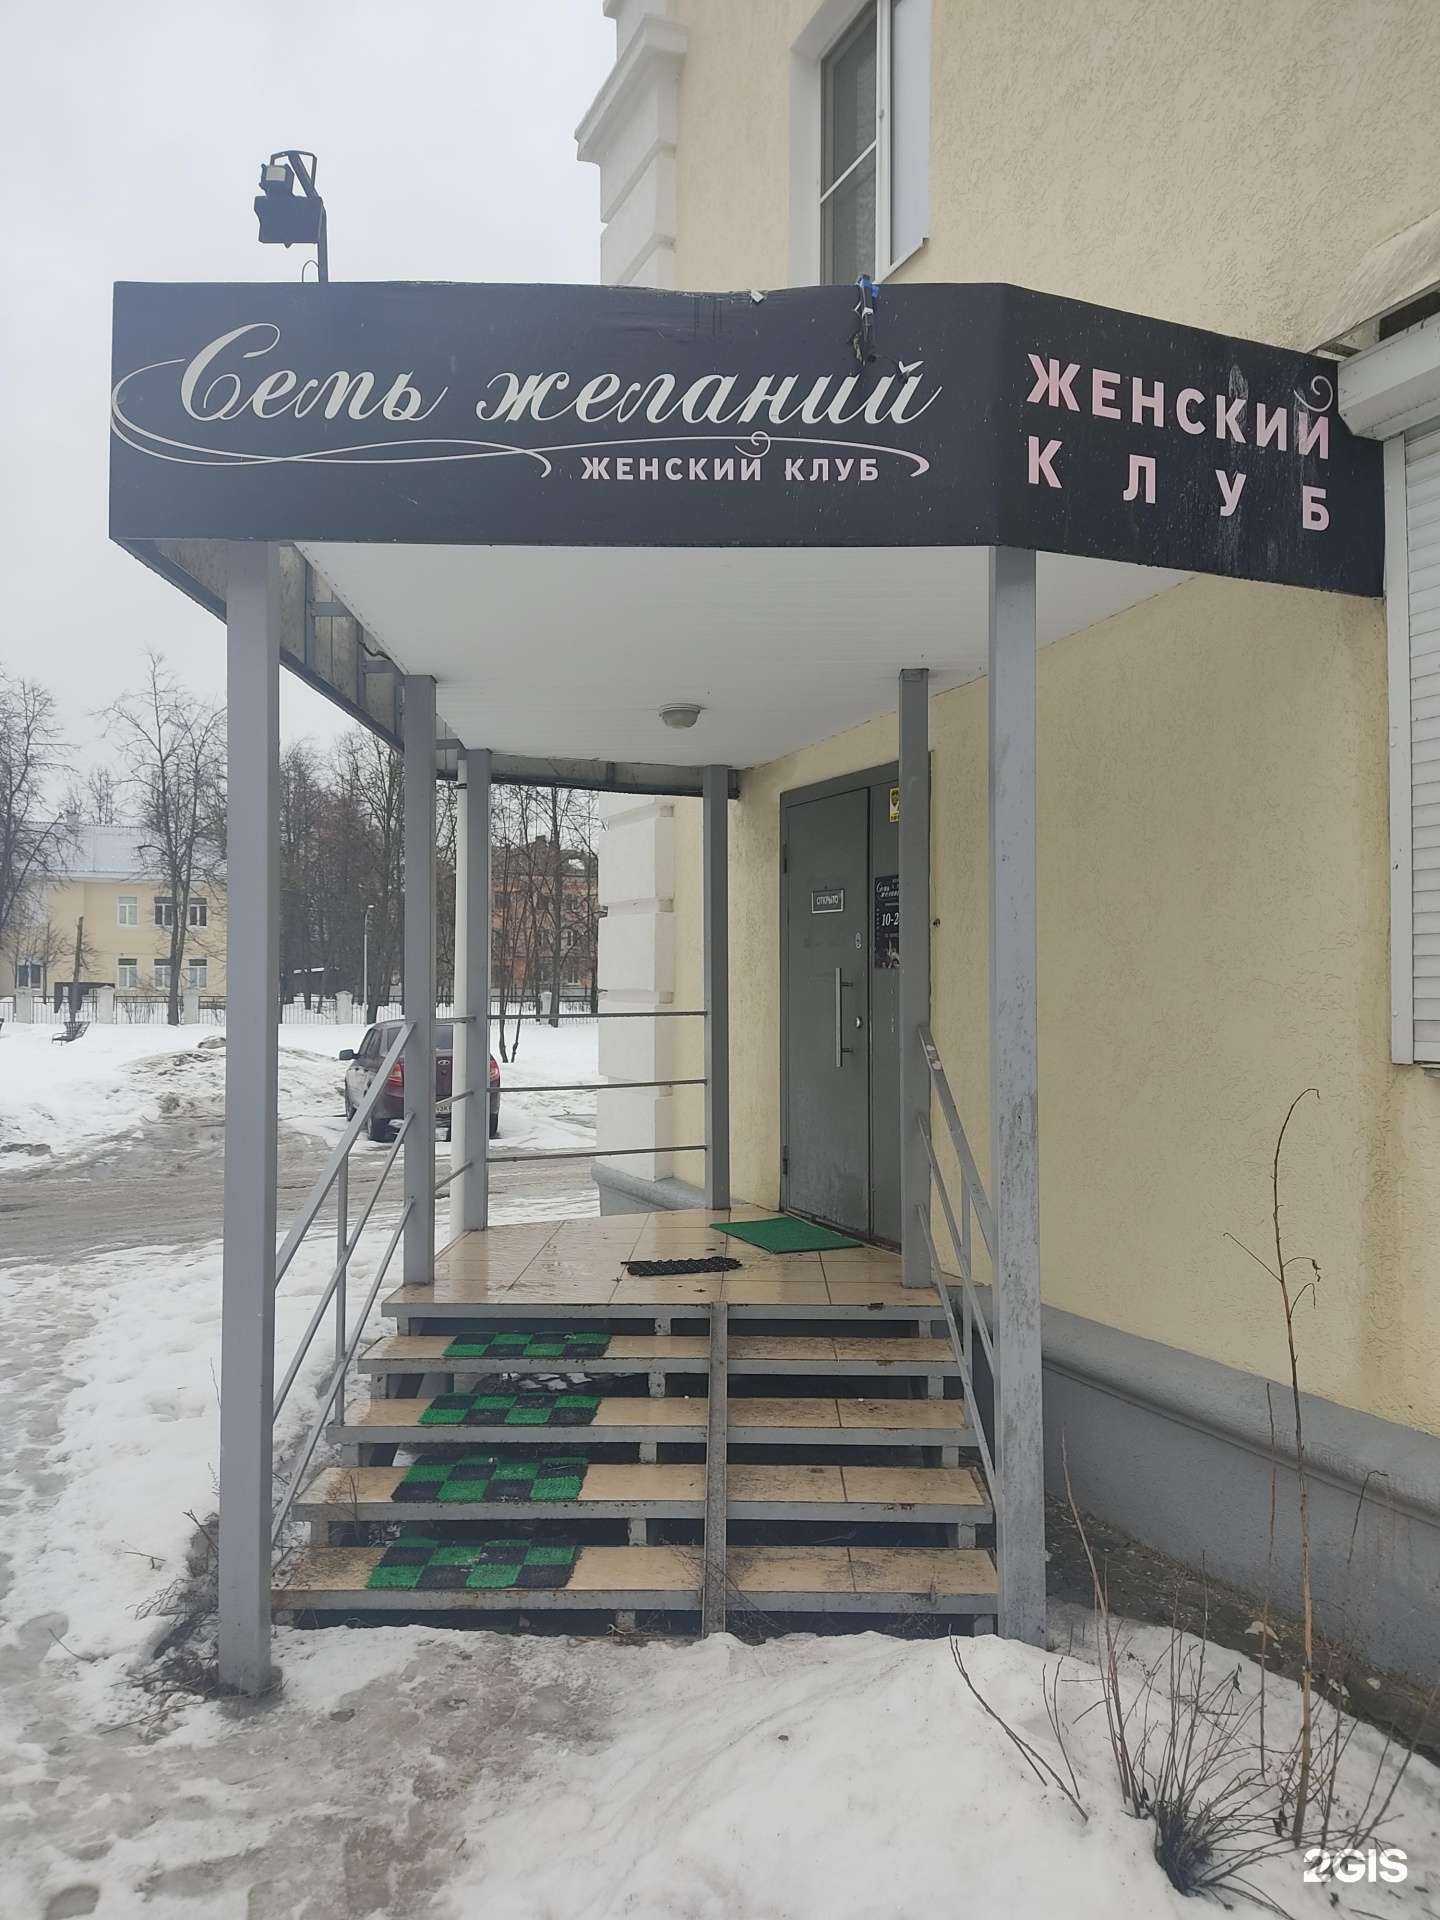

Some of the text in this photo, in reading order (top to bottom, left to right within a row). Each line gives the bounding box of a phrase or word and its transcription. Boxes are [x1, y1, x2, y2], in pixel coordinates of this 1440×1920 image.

[180, 322, 943, 425] Семь желаний
[1026, 353, 1332, 460] ЖЕНСКИЙ
[580, 455, 880, 482] ЖЕНСКИЙ КЛУБ
[1027, 435, 1331, 532] КЛУБ
[881, 912, 899, 926] 10-2
